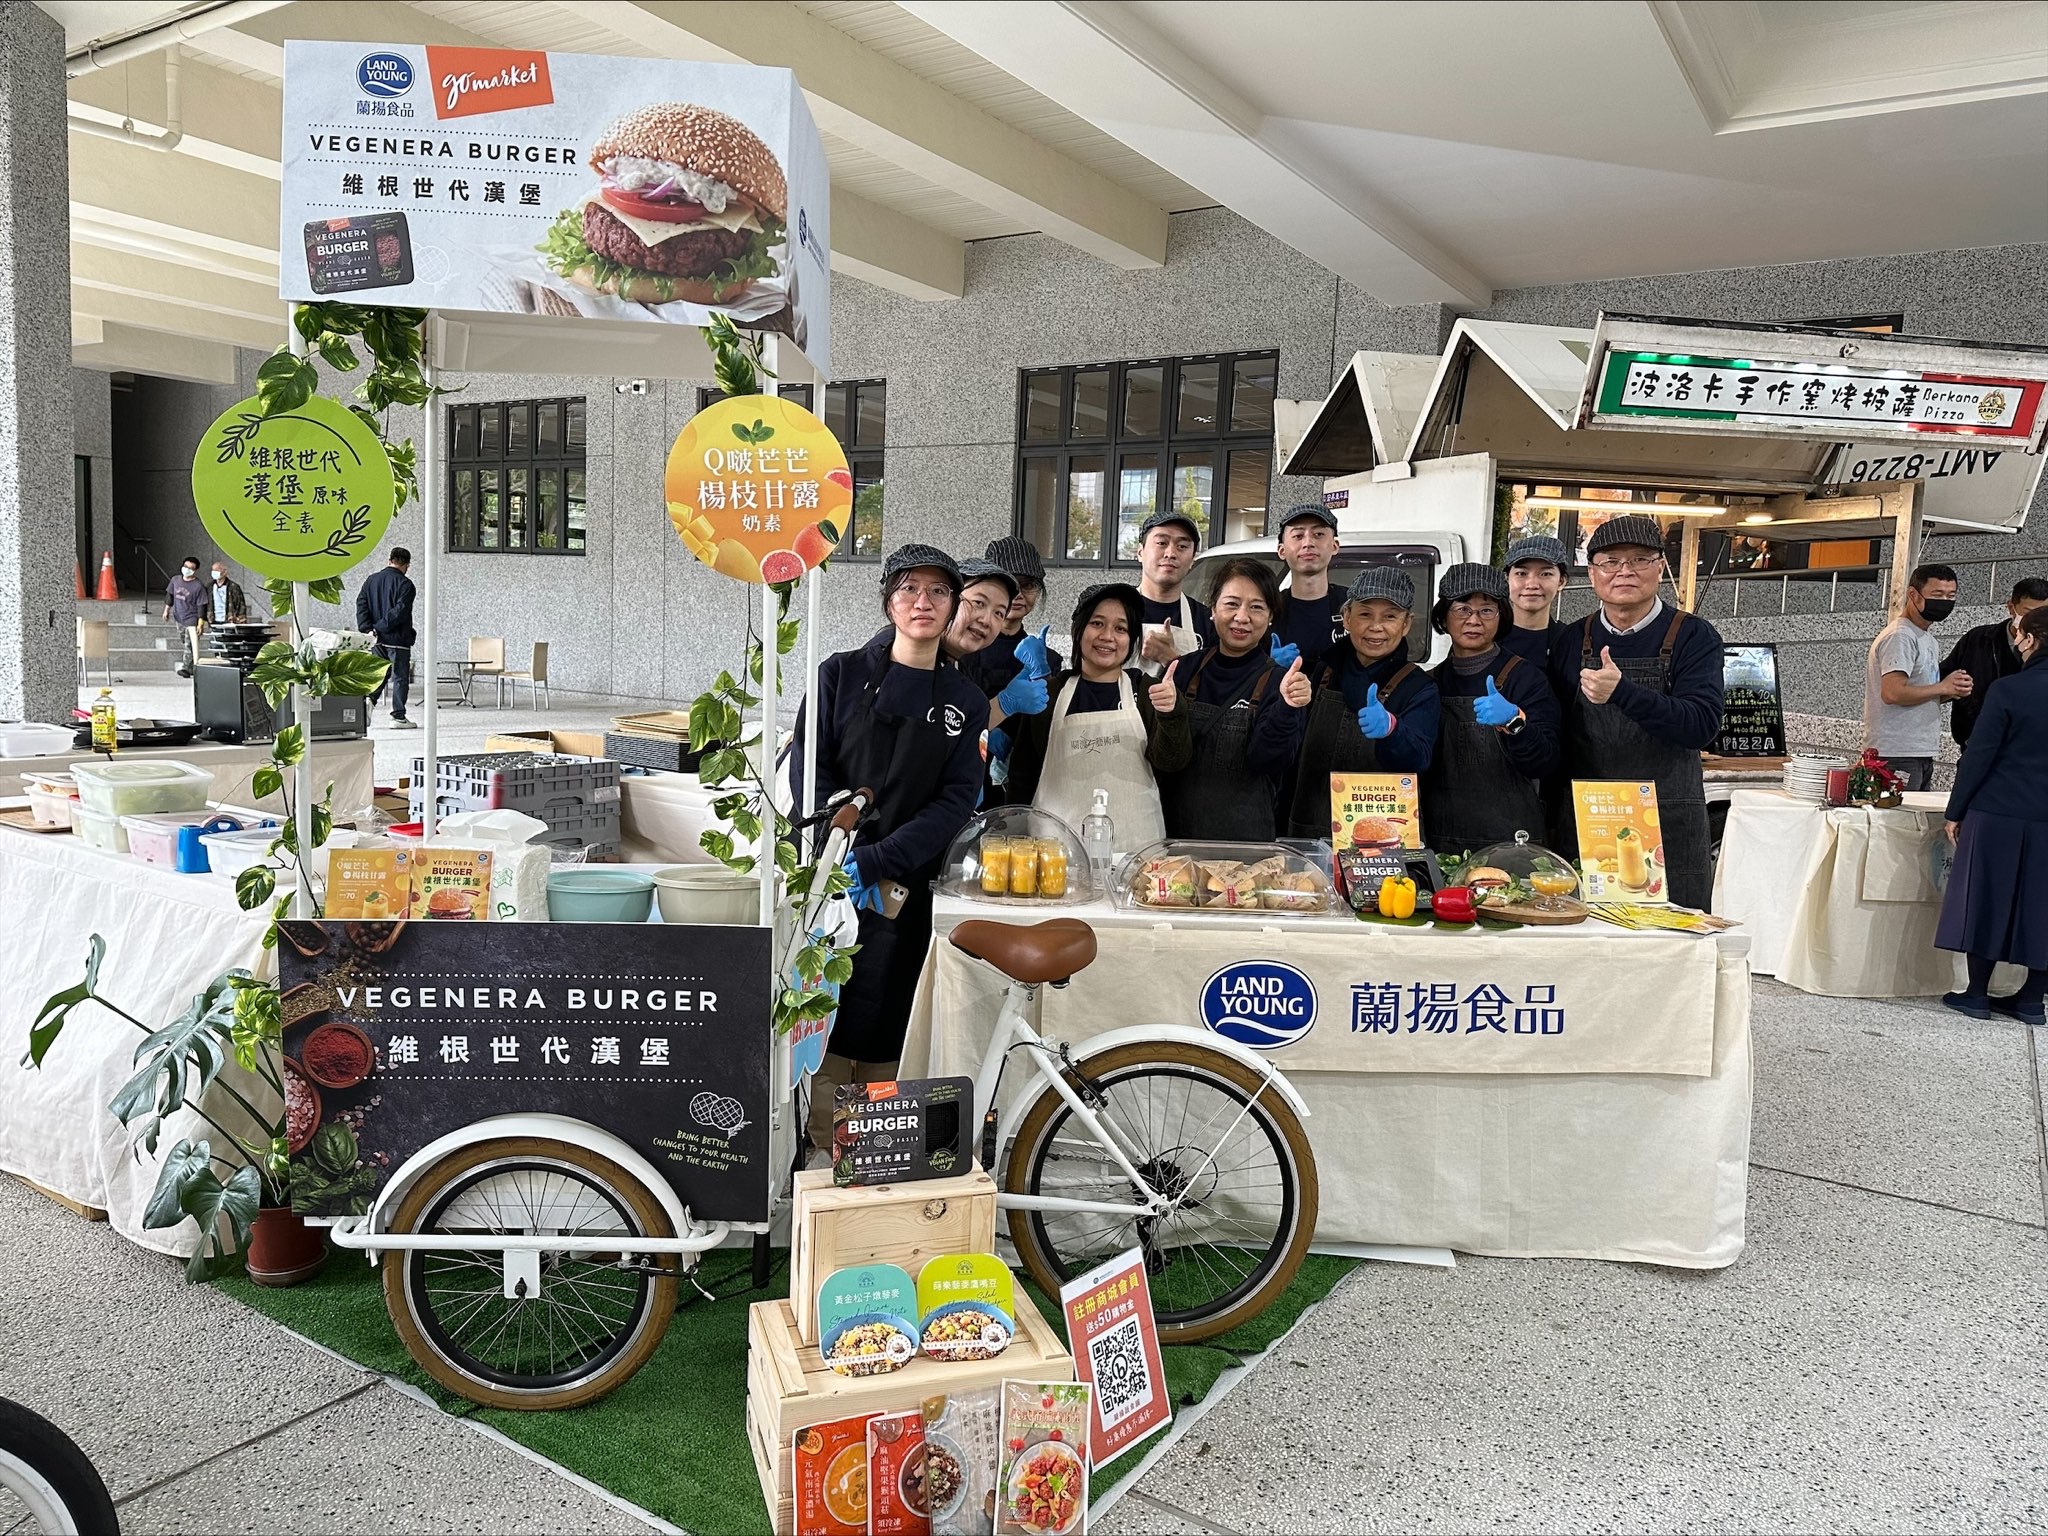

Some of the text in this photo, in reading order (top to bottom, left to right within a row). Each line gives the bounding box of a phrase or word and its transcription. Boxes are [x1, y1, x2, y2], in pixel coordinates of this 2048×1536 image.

[366, 60, 398, 71] LAND
[367, 70, 408, 82] YOUNG
[356, 100, 414, 117] 蘭揚食品
[310, 134, 578, 165] VEGENERA BURGER
[342, 173, 542, 207] 維根世代漢堡
[315, 229, 367, 241] VEGENERA
[317, 240, 369, 256] BURGER
[1631, 370, 1920, 416] 波洛卡手作窯烤披薩
[1923, 388, 1979, 403] Berkana
[1924, 406, 1964, 420] Pizza
[250, 447, 341, 473] 維根世代
[704, 448, 808, 476] Q啵芒芒
[1850, 449, 2003, 483] AMT-8226
[244, 473, 348, 505] 漢堡 原味
[697, 480, 820, 509] 楊枝甘露
[272, 510, 314, 533] 全素
[742, 514, 781, 532] 奶素
[1351, 793, 1397, 801] BURGER
[432, 867, 473, 876] BURGER
[1221, 976, 1284, 995] LAND
[336, 987, 719, 1012] VEGENERA BURGER
[1221, 996, 1304, 1016] YOUNG
[1350, 982, 1565, 1035] 蘭揚食品
[388, 1035, 671, 1066] 維根世代漢堡
[848, 1100, 919, 1114] VEGENERA
[848, 1115, 919, 1134] BURGER
[676, 1130, 730, 1149] BRING BETTER
[653, 1137, 685, 1151] CHANGES
[700, 1147, 719, 1158] YOUR
[720, 1152, 749, 1164] HEALTH
[668, 1152, 683, 1161] AND
[686, 1155, 700, 1165] THE
[1073, 1272, 1140, 1321] 註冊商城會員
